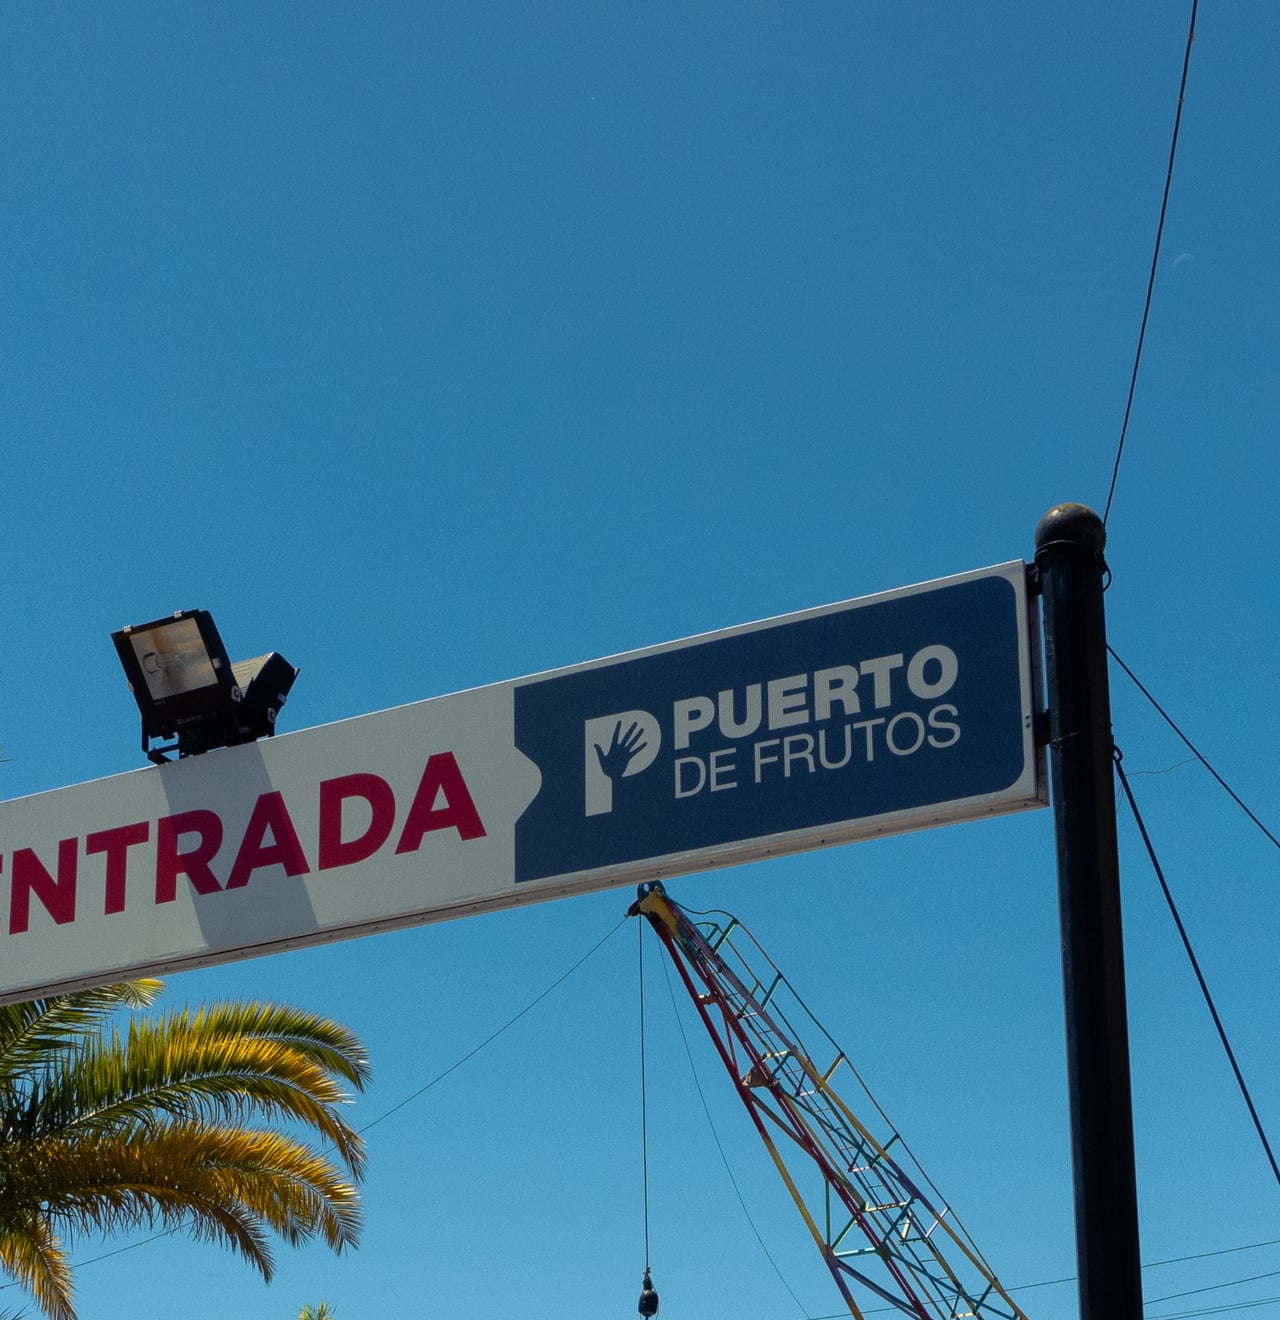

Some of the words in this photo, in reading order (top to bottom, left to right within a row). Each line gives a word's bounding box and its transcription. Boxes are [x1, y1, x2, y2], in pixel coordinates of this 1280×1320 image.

[674, 644, 958, 750] PUERTO
[674, 747, 738, 799] DE
[754, 704, 961, 784] FRUTOS
